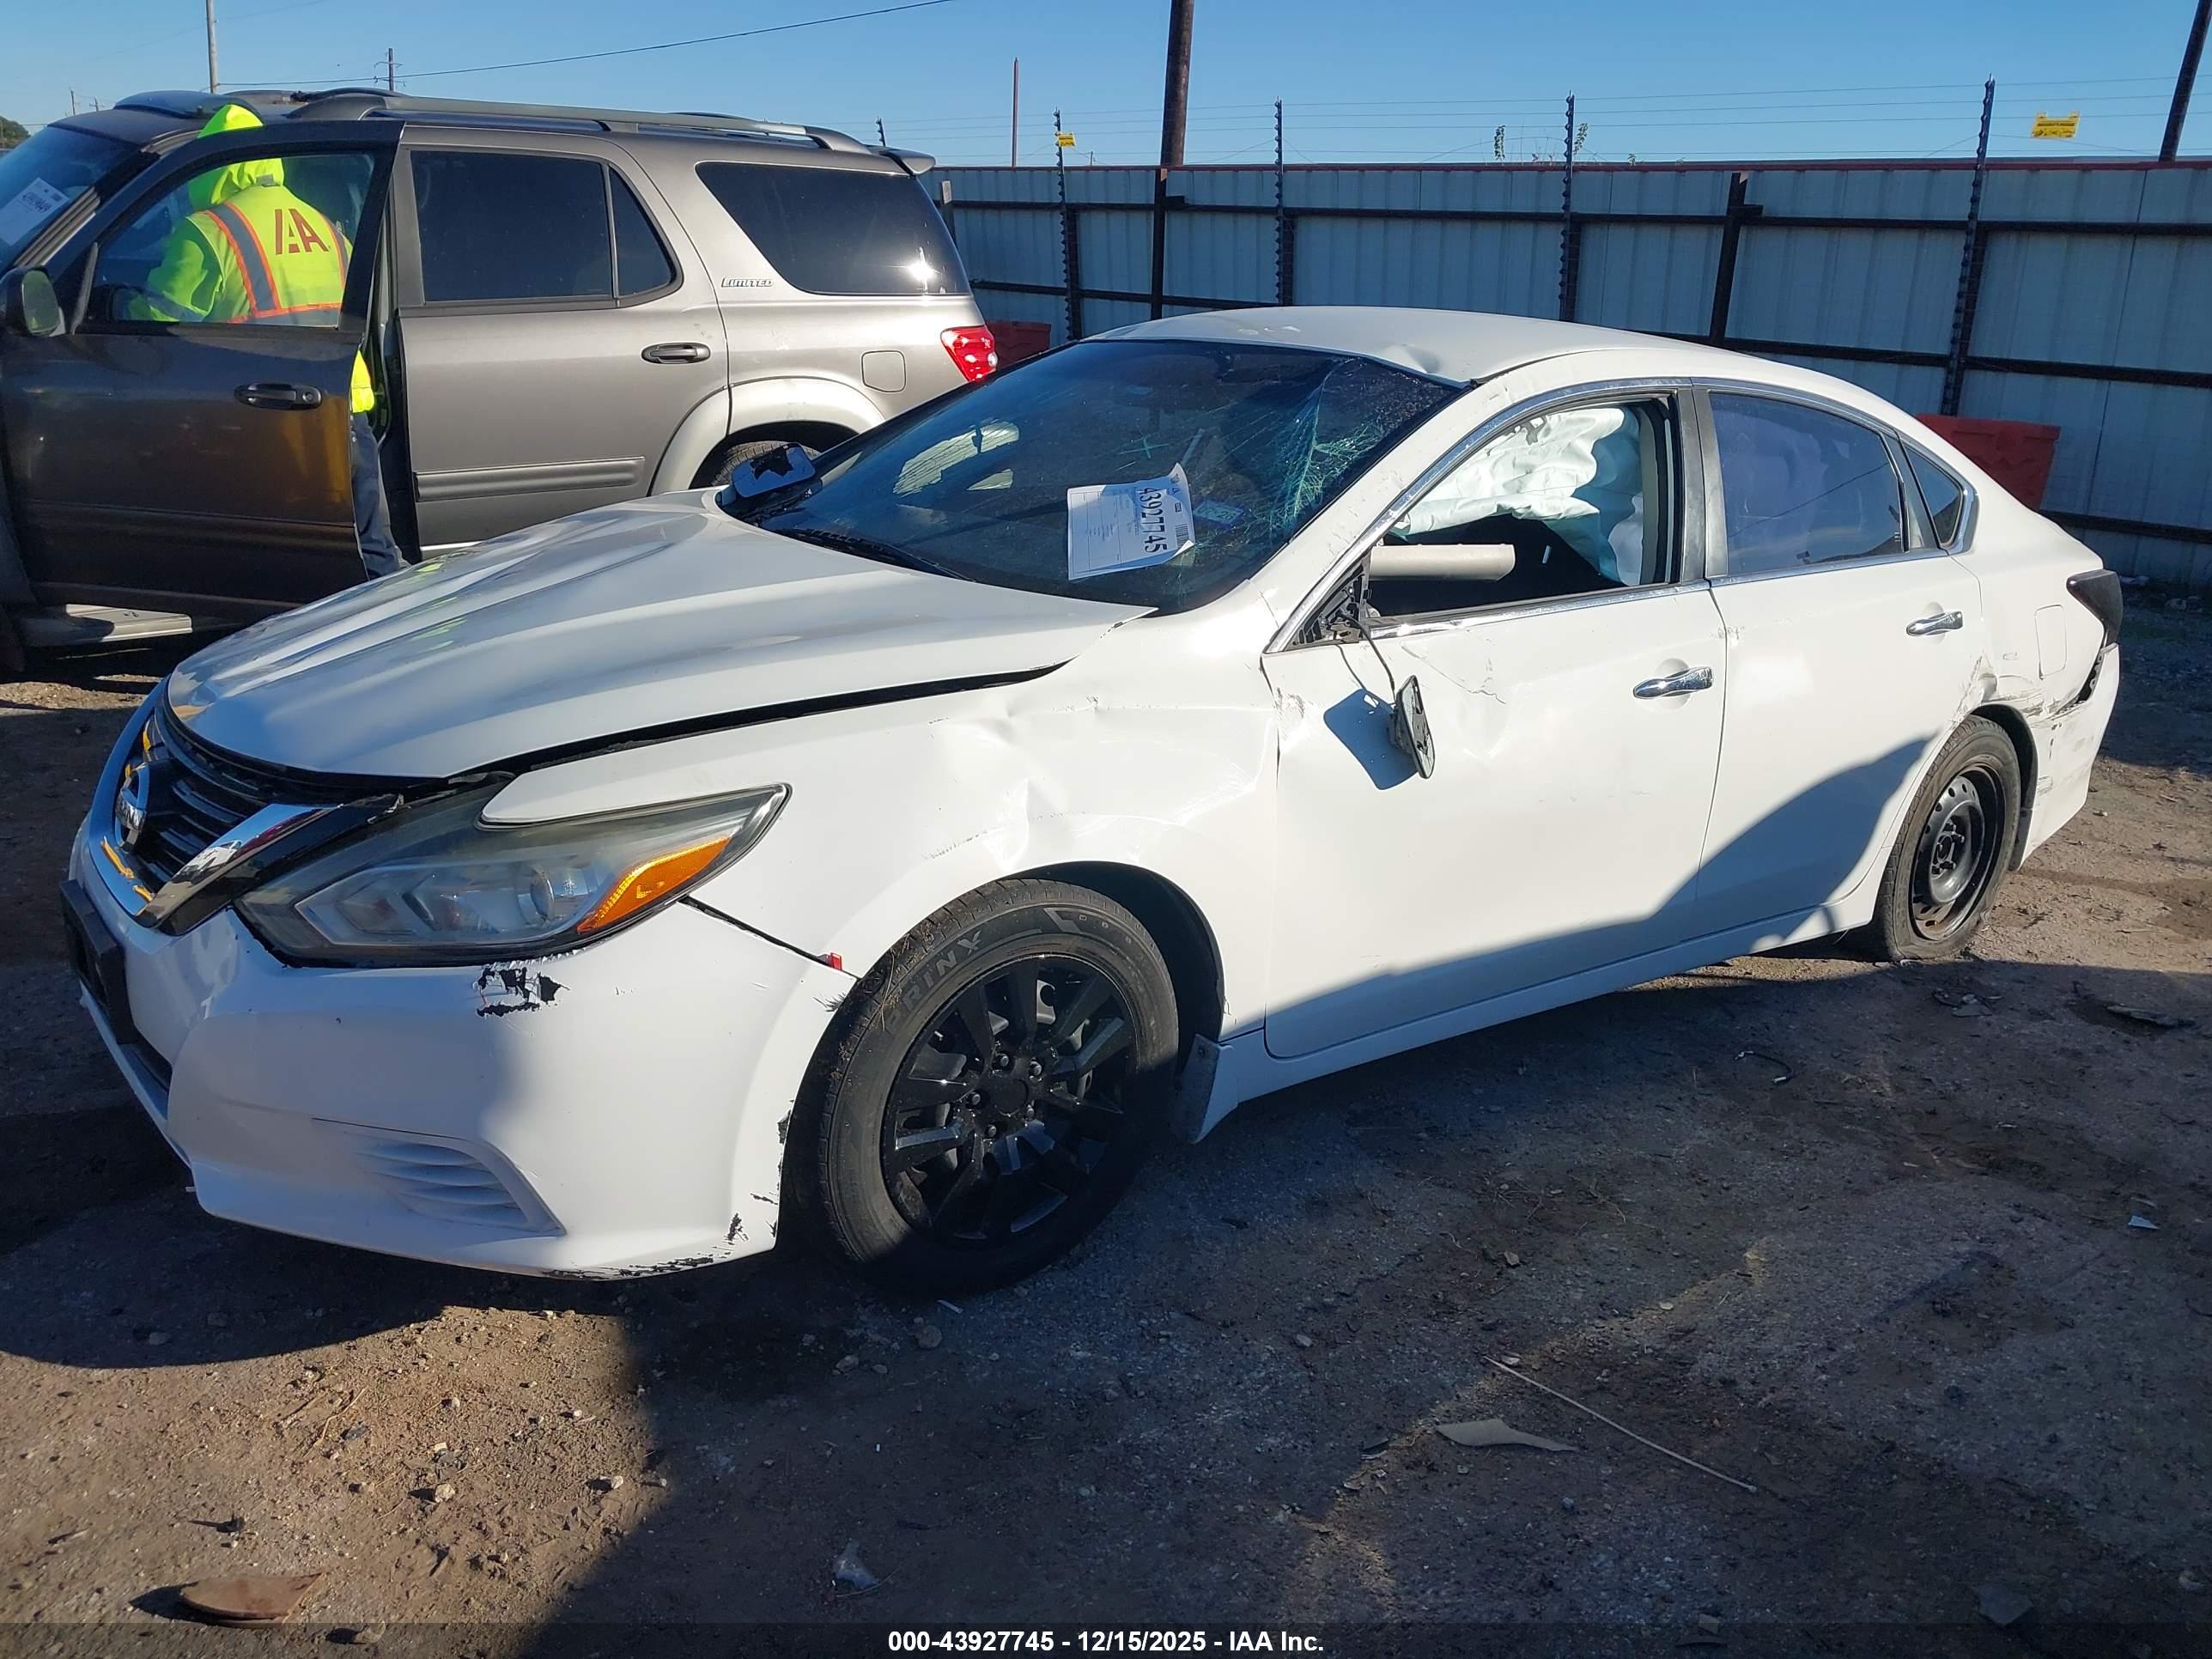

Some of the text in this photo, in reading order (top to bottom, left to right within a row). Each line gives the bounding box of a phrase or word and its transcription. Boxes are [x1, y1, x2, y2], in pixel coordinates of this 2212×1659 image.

[274, 208, 330, 255] IAA
[720, 276, 775, 288] LIMITED
[1139, 487, 1168, 553] 43927745
[885, 930, 982, 1030] PRINX
